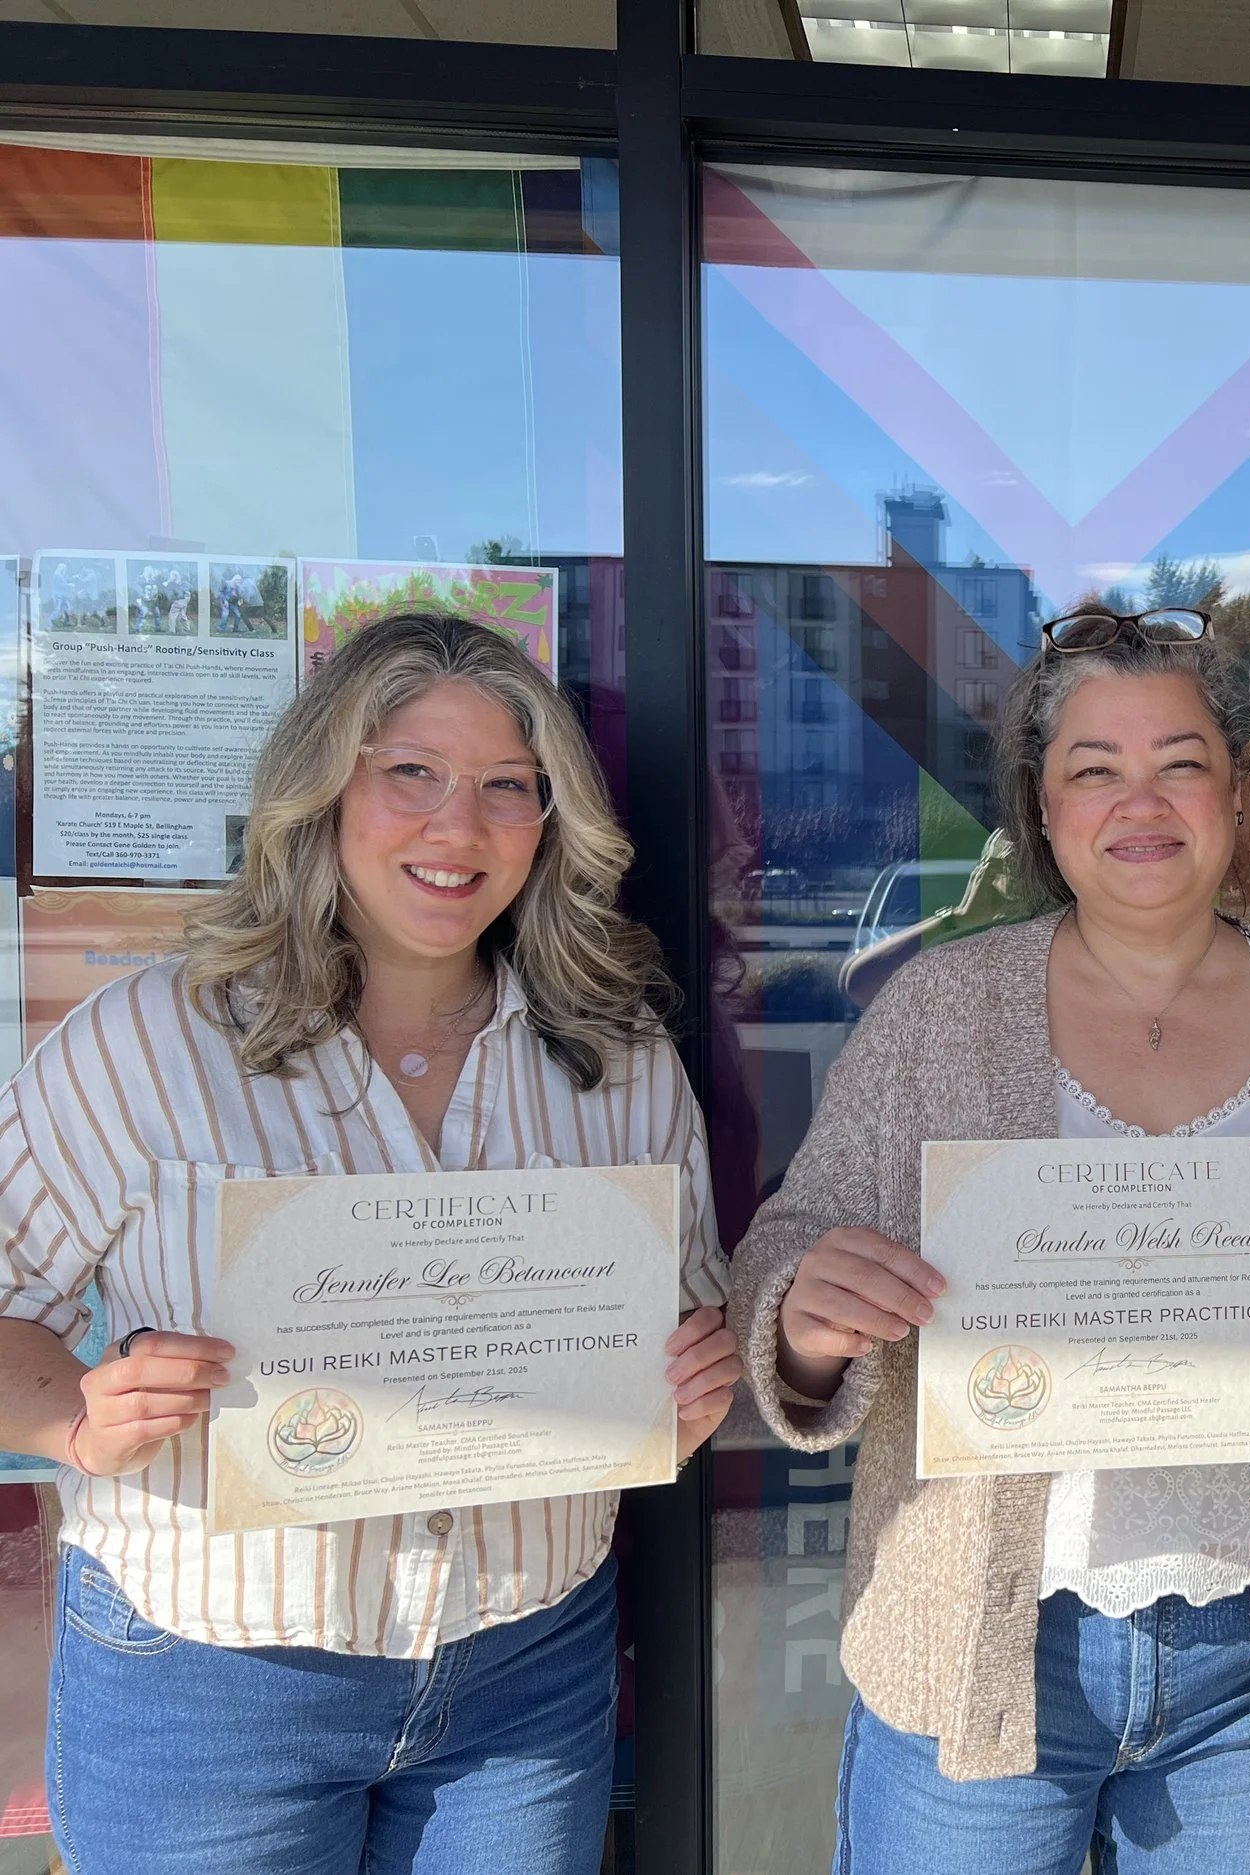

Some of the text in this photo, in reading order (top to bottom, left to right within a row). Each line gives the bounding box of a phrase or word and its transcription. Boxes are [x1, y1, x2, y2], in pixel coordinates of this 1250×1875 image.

[52, 642, 83, 652] Group
[156, 646, 248, 658] Rooting/Sensitivity
[250, 648, 275, 658] Class
[84, 951, 156, 966] Beaded
[1038, 1161, 1220, 1183] CERTIFICATE
[1092, 1184, 1172, 1193] OF COMPLETION
[351, 1193, 558, 1221] CERTIFICATE
[413, 1218, 502, 1230] OF COMPLETION
[1016, 1224, 1106, 1254] Sandra
[1116, 1218, 1183, 1250] Welsh
[293, 1255, 616, 1304] Jennifer Lee Betancourt
[992, 1281, 1038, 1290] successfully
[1039, 1280, 1077, 1289] completed
[1093, 1278, 1120, 1287] training
[1122, 1277, 1170, 1286] requirements
[1186, 1275, 1228, 1283] attunement
[1111, 1291, 1141, 1300] granted
[295, 1322, 348, 1332] successfully
[350, 1319, 394, 1329] completed
[412, 1316, 442, 1324] training
[444, 1312, 498, 1323] requirements
[499, 1310, 515, 1318] and
[516, 1307, 561, 1317] attunement
[576, 1304, 596, 1312] Reiki
[598, 1303, 624, 1311] Master
[962, 1315, 1007, 1330] USUI
[1016, 1312, 1065, 1328] REIKI
[1074, 1309, 1152, 1326] MASTER
[380, 1331, 403, 1339] Level
[432, 1327, 464, 1337] granted
[466, 1324, 512, 1333] certification
[1069, 1336, 1105, 1344] Presented
[1120, 1334, 1158, 1343] September
[261, 1333, 638, 1376] USUI REIKI MASTER PRACTITIONER
[384, 1374, 425, 1384] Presented
[440, 1370, 484, 1380] September
[508, 1366, 528, 1374] 2025
[1100, 1385, 1142, 1393] SAMANTHA
[418, 1419, 493, 1432] SAMANTHA BEPPU
